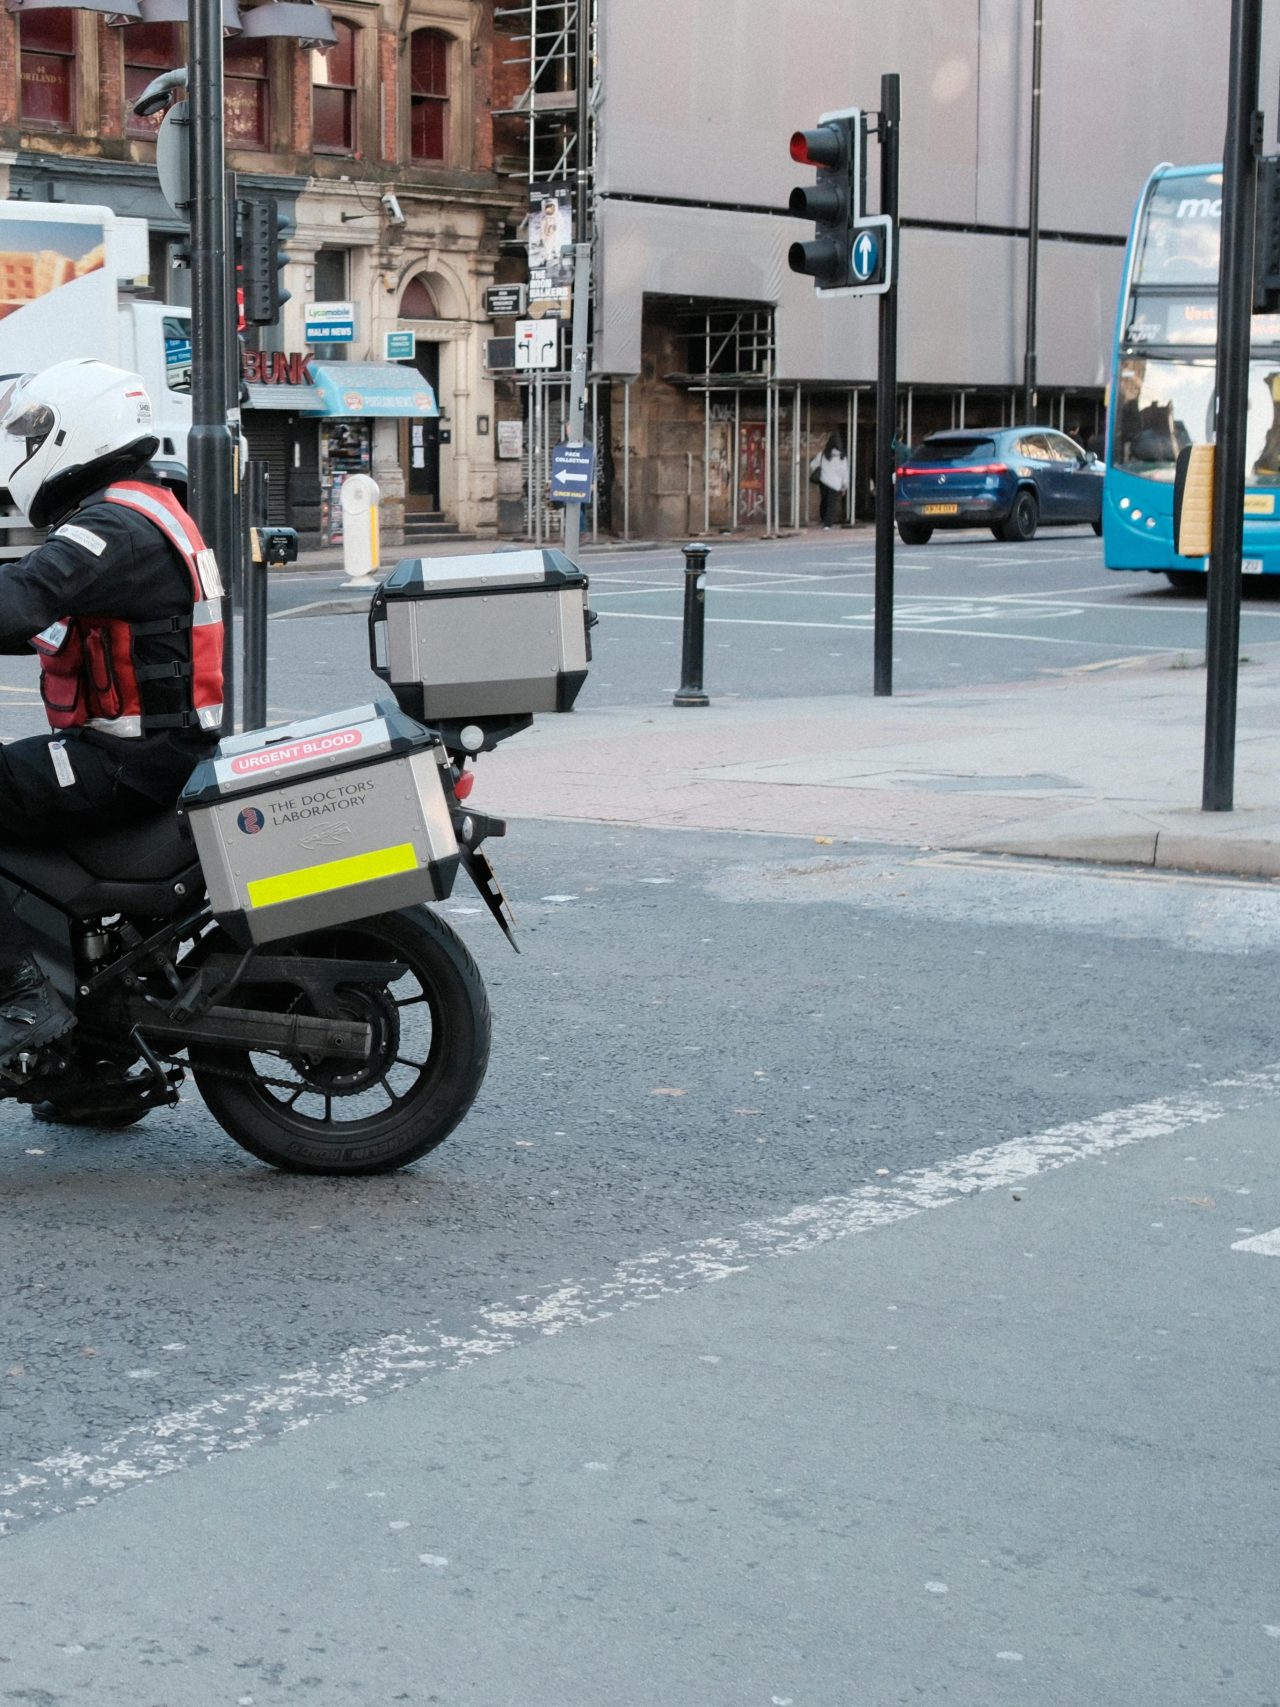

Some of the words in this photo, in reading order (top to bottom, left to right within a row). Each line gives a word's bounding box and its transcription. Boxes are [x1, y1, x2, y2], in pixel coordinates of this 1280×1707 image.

[530, 270, 546, 279] THE
[309, 308, 350, 317] Lycamobile
[331, 327, 351, 336] NEWS
[242, 350, 315, 385] BUNK
[238, 746, 300, 770] URGENT
[303, 733, 355, 754] BLOOD
[268, 799, 297, 813] THE
[301, 779, 375, 806] DOCTORS
[272, 794, 366, 826] LABORATORY
